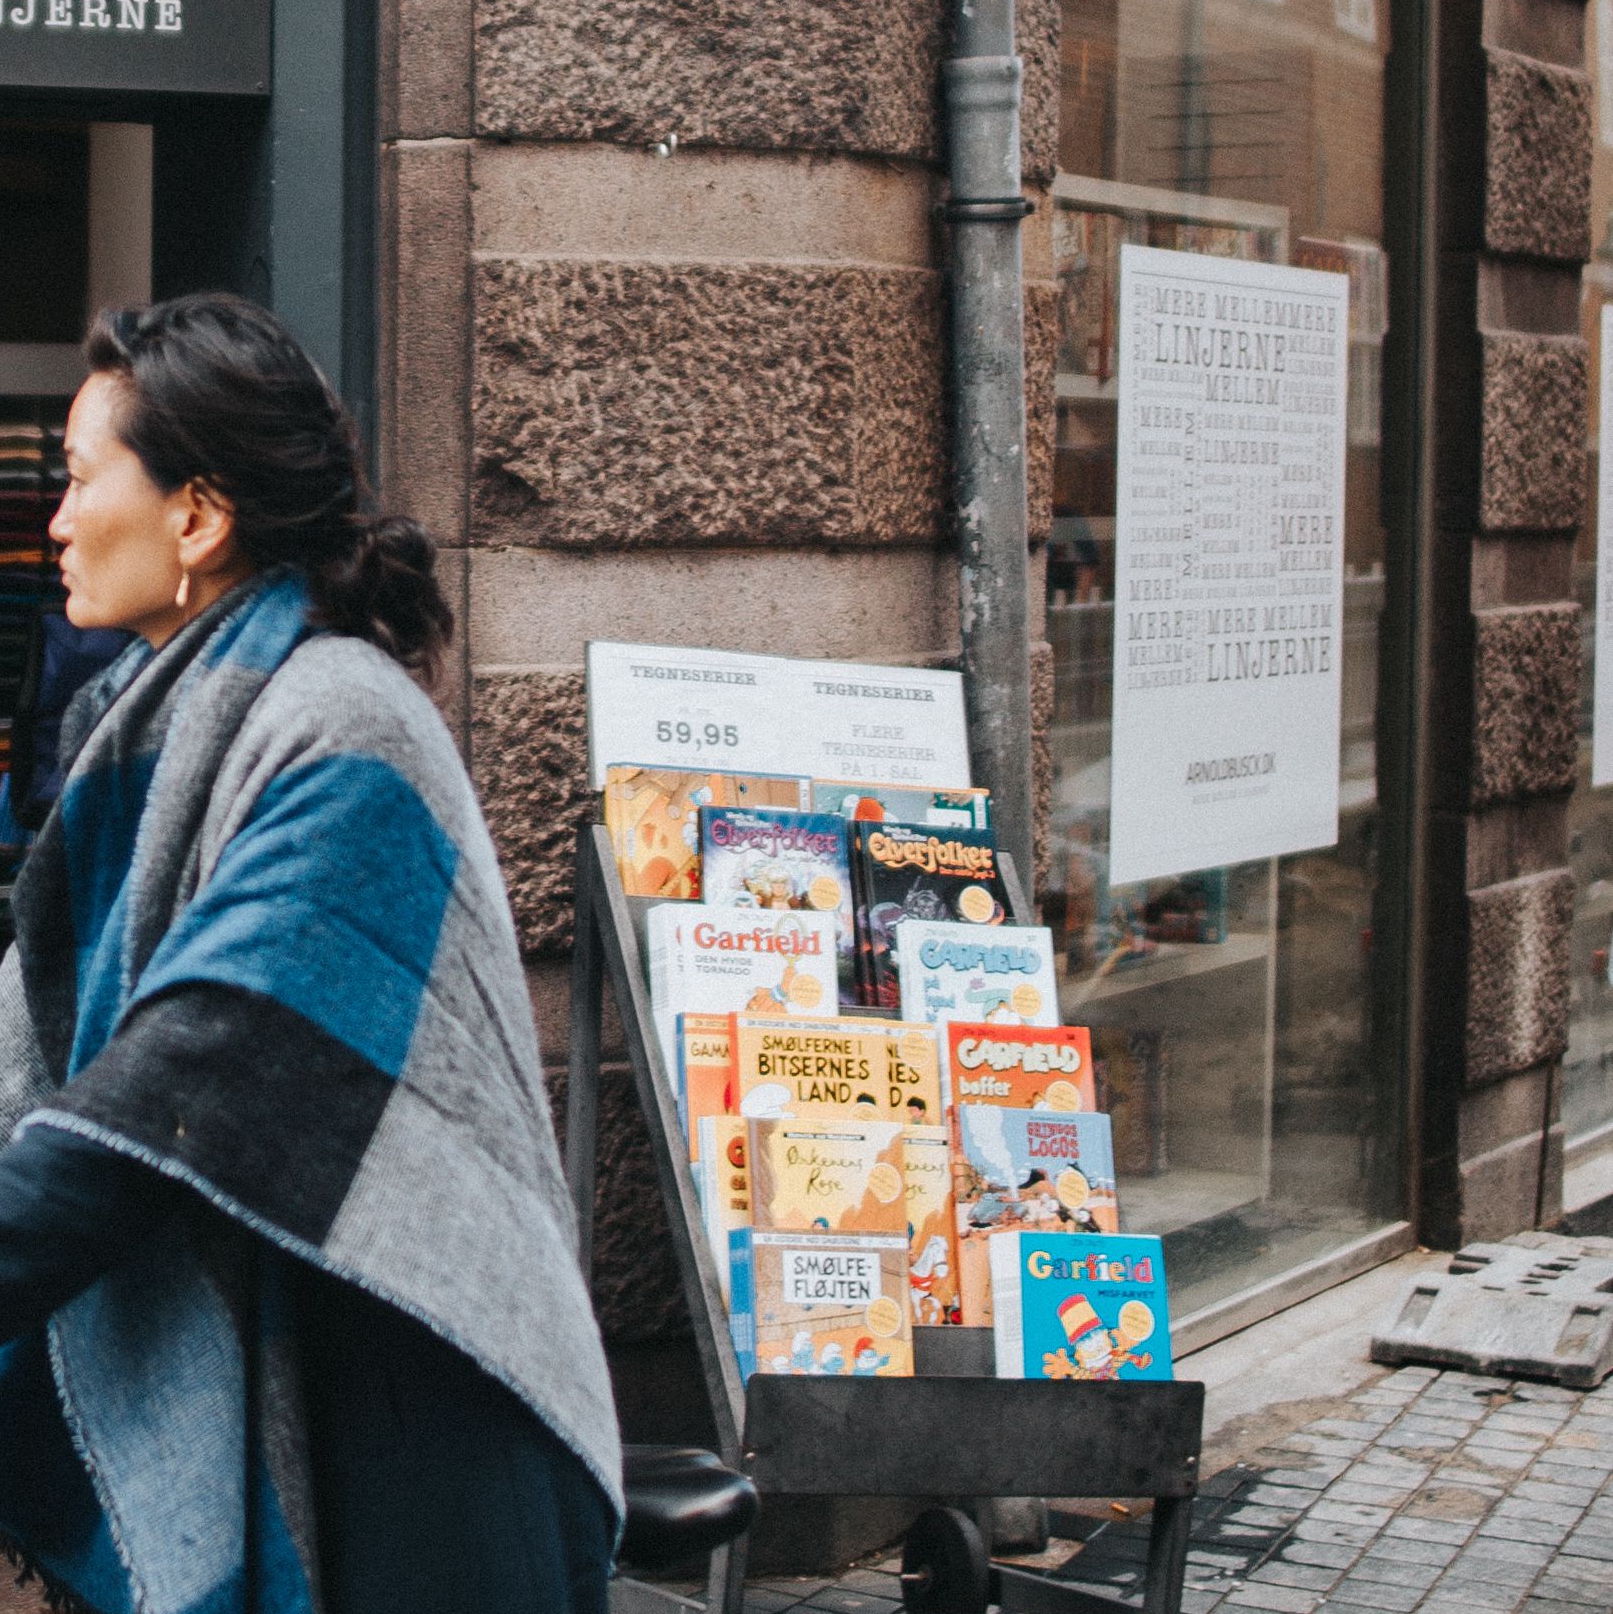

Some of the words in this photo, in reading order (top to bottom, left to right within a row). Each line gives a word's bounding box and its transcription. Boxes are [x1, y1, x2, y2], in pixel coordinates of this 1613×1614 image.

[1155, 287, 1207, 319] MERE
[1215, 294, 1286, 327] MELLEM
[1288, 302, 1336, 333] MERE
[1154, 322, 1286, 373] LINJERNE
[1205, 373, 1281, 405] MELLEM
[1139, 405, 1183, 430] MERE
[1279, 515, 1333, 545] MERE
[1128, 610, 1184, 641] MERE
[1207, 607, 1257, 635] MERE
[1263, 604, 1333, 632] MELLEM
[1207, 636, 1331, 682] LINJERNE
[630, 665, 757, 686] TEGNESERIER
[813, 681, 935, 702] TEGNESERIER
[656, 720, 739, 752] 59,95
[693, 922, 822, 956] Garfield
[694, 954, 719, 964] DEN
[696, 965, 752, 976] TORNADO
[919, 938, 1043, 975] GARFIELD
[762, 1035, 853, 1055] SMØLFERNE
[957, 1037, 1083, 1075] GARFIELD
[757, 1052, 871, 1081] BITSERNES
[797, 1082, 853, 1105] LAND
[793, 1255, 873, 1277] SMØLFE-
[1027, 1250, 1155, 1285] Garfield
[794, 1279, 871, 1300] FLØJTEN
[1097, 1289, 1155, 1300] MISFARVET
